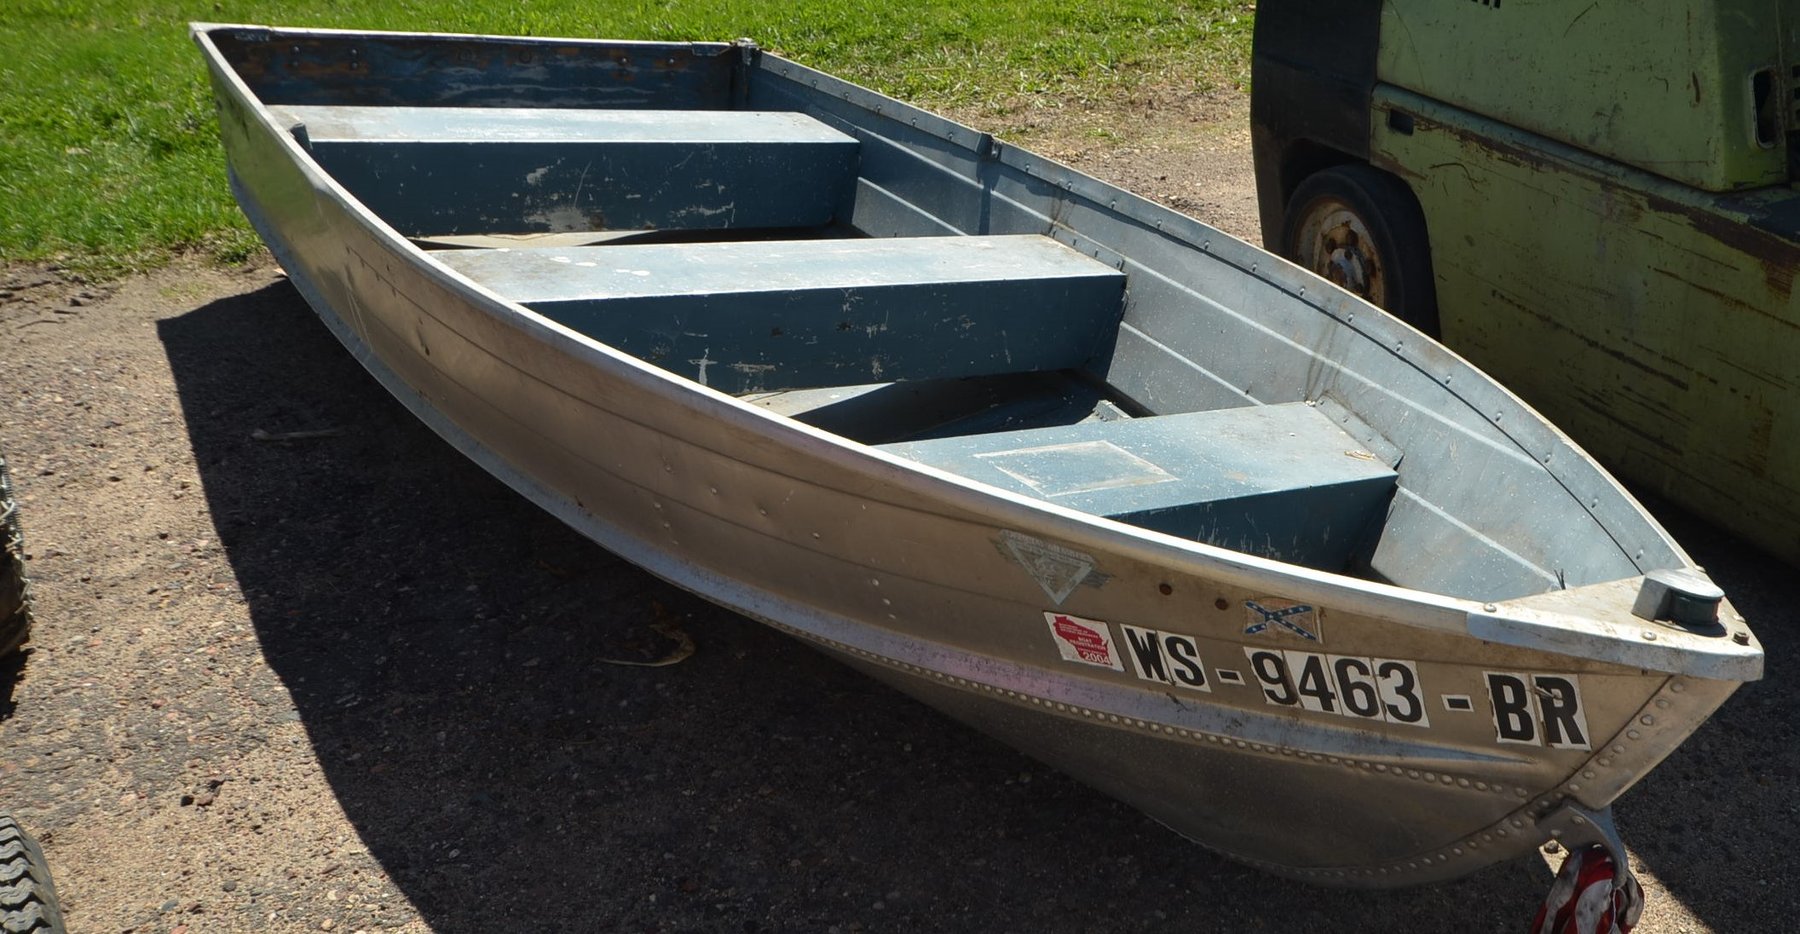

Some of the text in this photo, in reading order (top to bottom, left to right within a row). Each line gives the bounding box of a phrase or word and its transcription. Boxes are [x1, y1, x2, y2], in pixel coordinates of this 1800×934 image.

[1083, 651, 1110, 664] 2004
[1124, 627, 1206, 687] WS
[1252, 651, 1423, 723] 9463
[1487, 673, 1587, 745] BR
